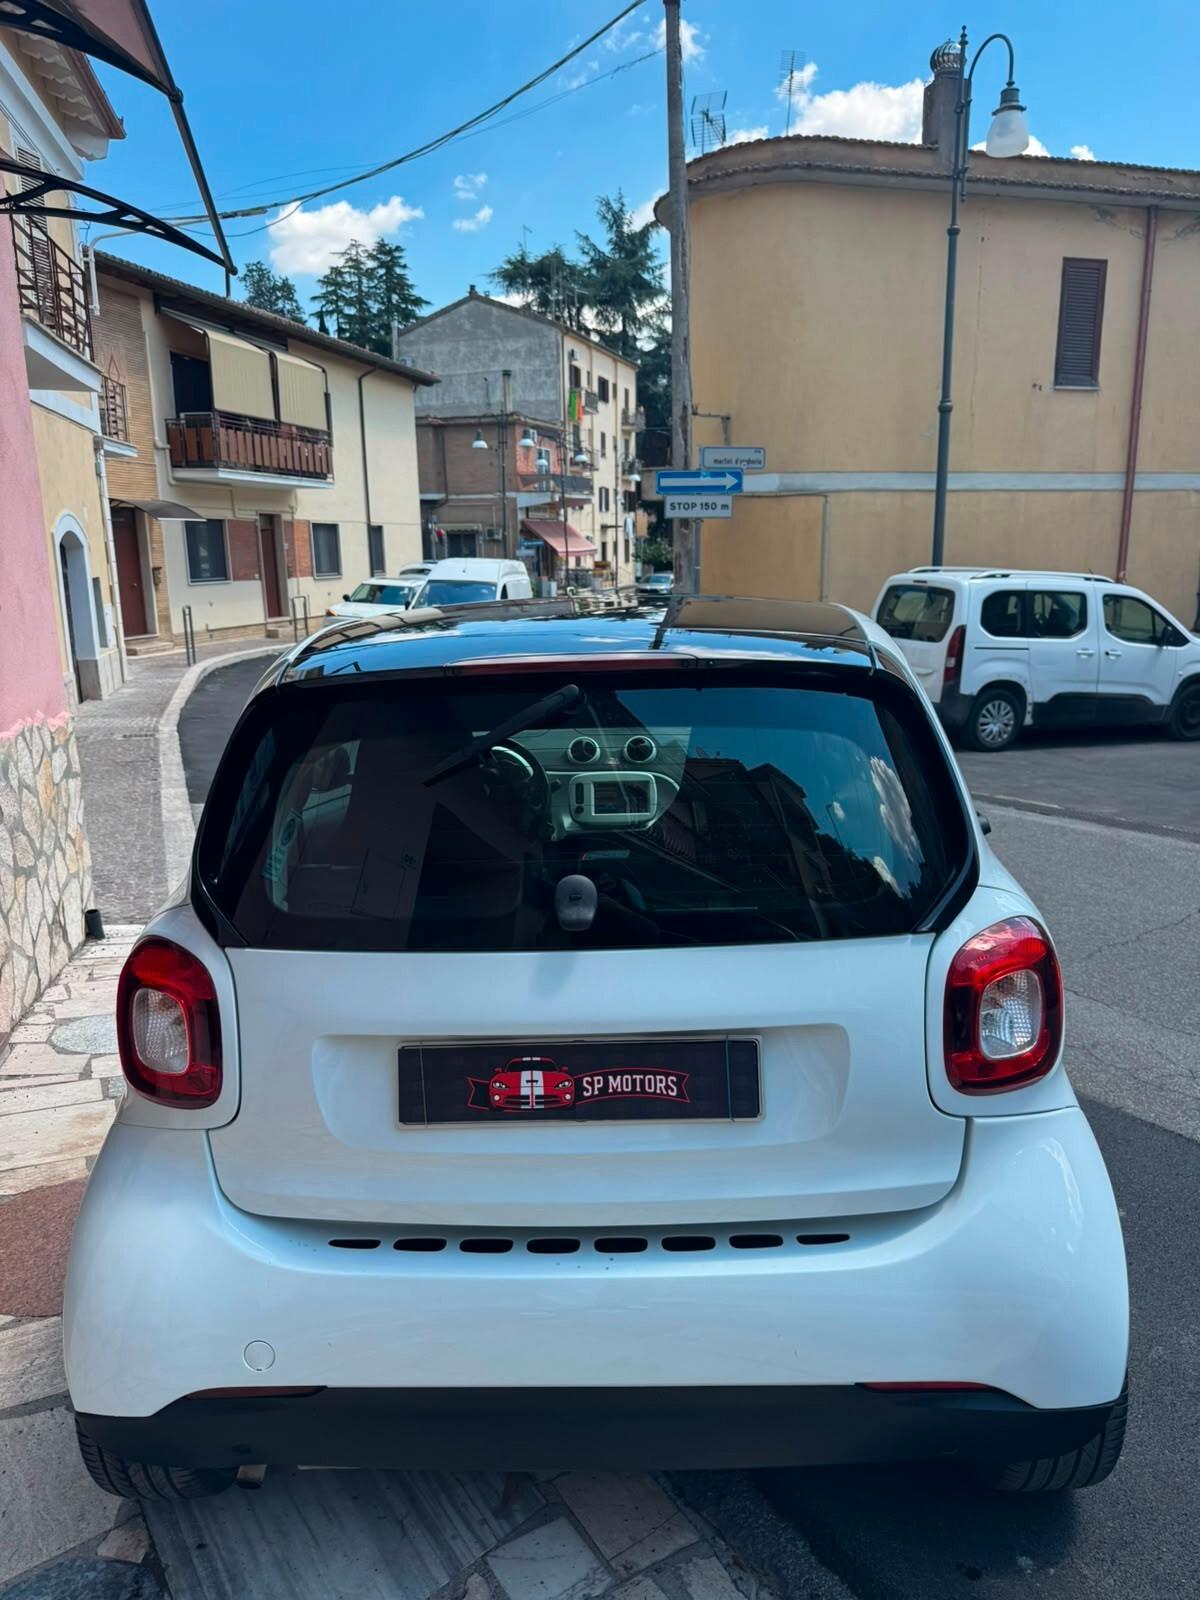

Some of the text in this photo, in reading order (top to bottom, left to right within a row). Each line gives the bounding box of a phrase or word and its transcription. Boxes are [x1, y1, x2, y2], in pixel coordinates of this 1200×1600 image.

[670, 502, 697, 511] STOP
[700, 502, 717, 511] 150
[583, 1074, 677, 1097] SP MOTORS
